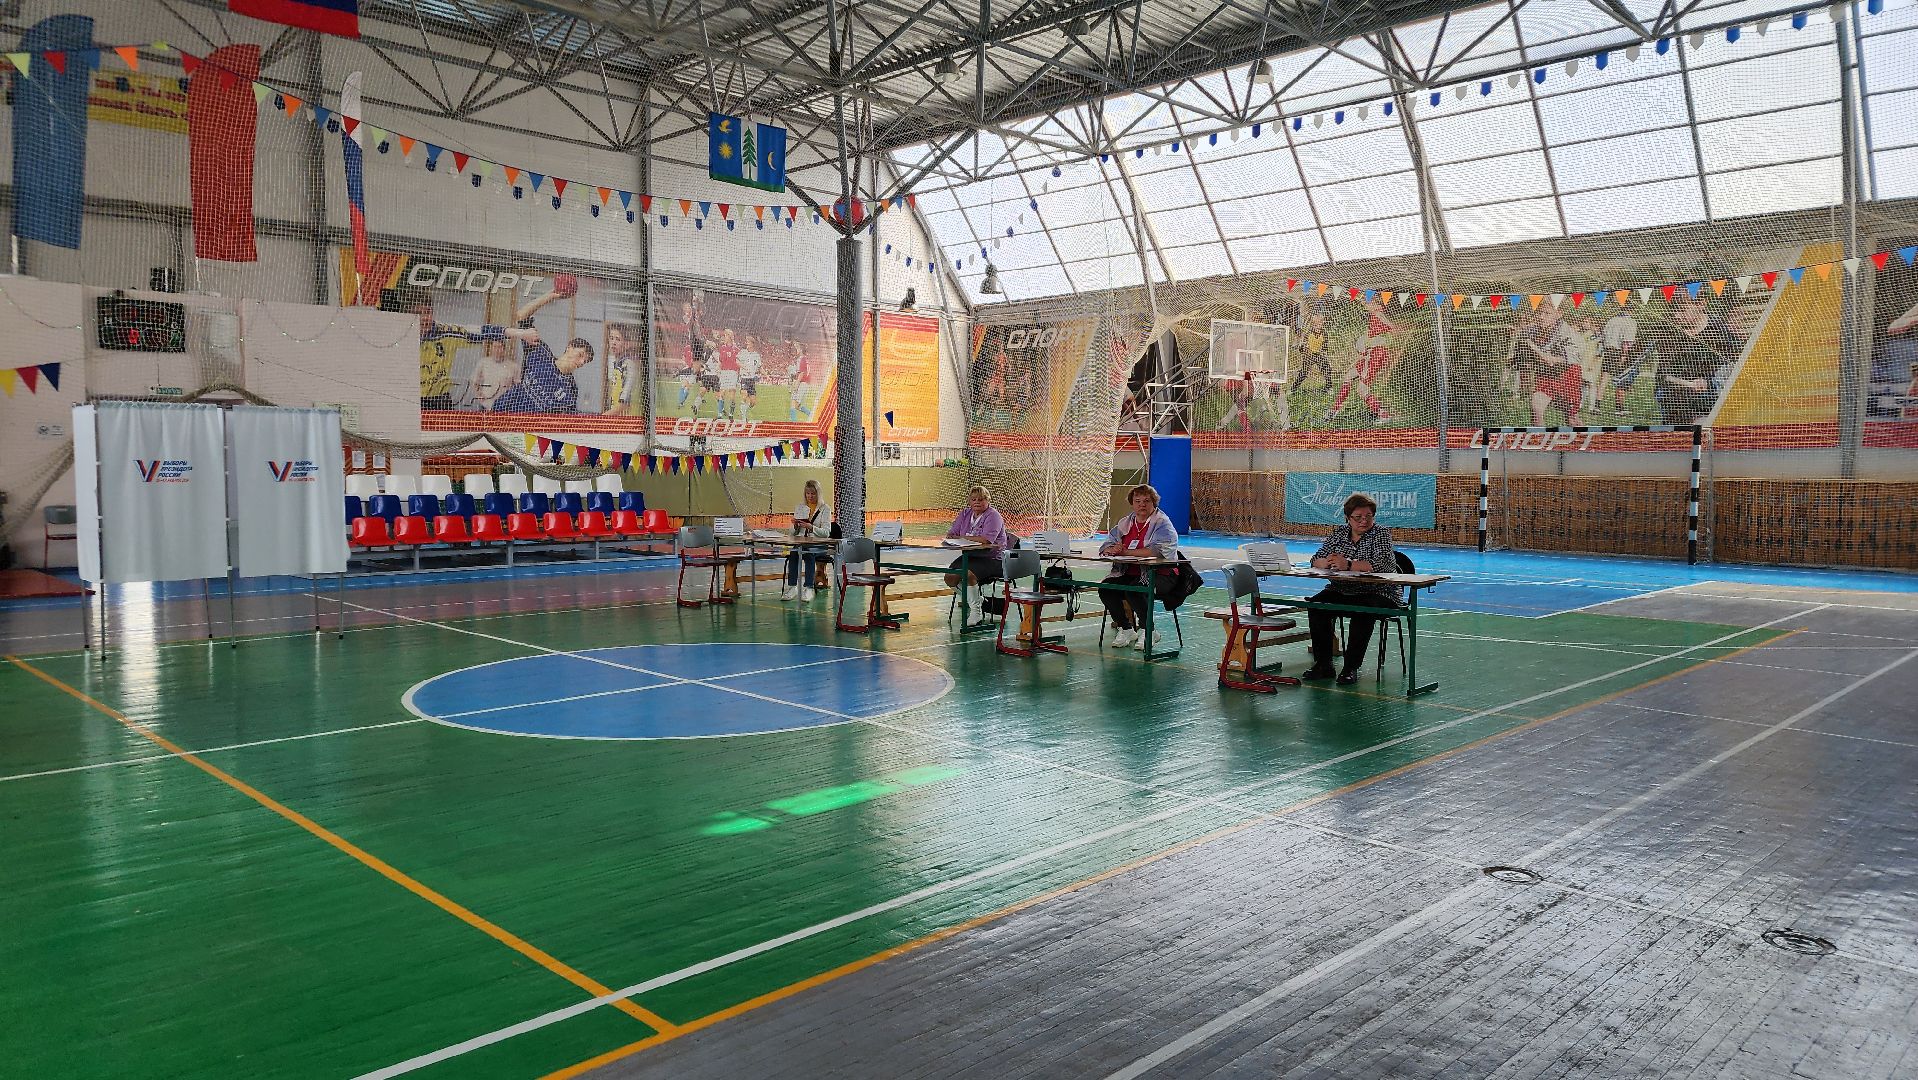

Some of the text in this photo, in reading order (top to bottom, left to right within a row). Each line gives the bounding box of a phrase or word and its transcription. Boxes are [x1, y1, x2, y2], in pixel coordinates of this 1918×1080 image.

[407, 263, 545, 298] СПОРТ
[674, 417, 762, 437] СПОРТ
[1470, 429, 1605, 451] СПОРТ
